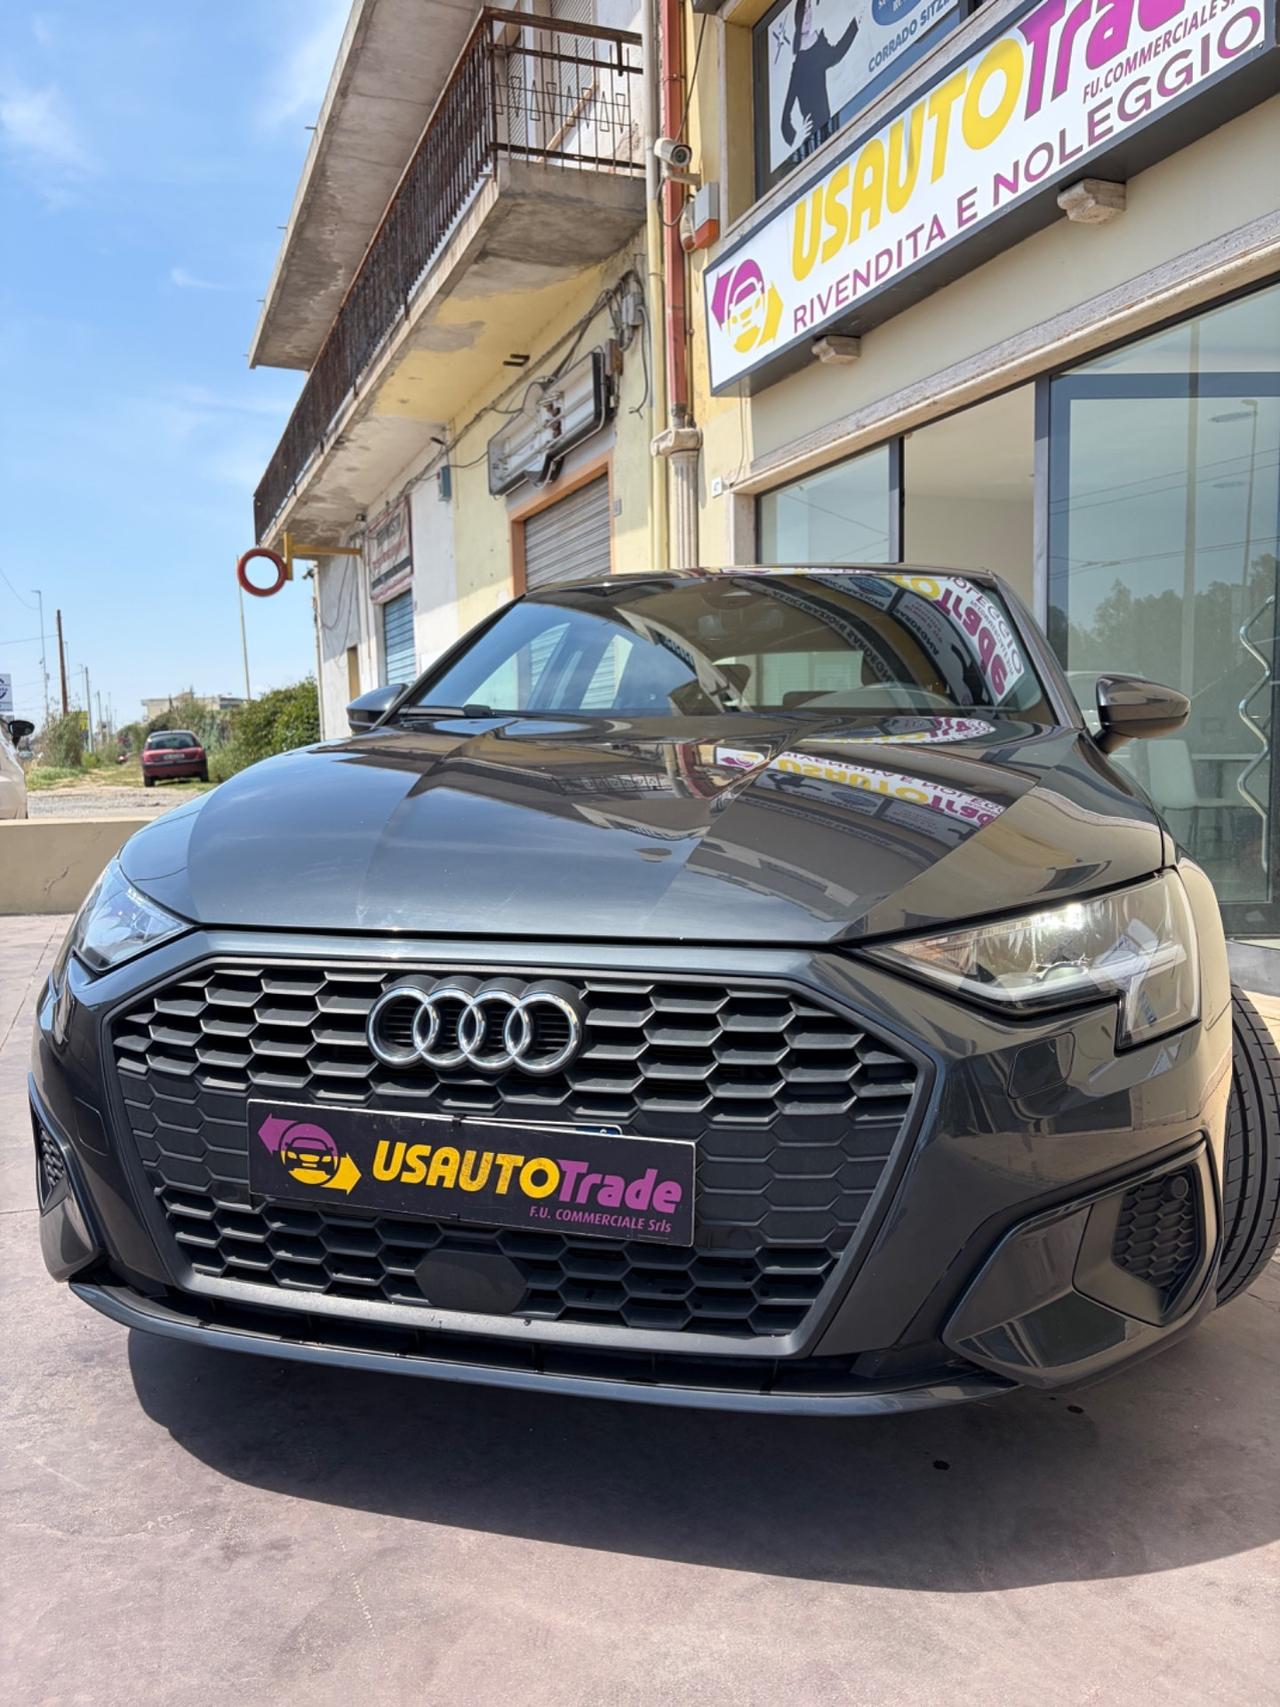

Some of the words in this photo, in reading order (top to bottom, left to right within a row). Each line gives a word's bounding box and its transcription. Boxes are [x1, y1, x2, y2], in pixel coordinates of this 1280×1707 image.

[868, 18, 918, 73] CORRADO
[793, 214, 947, 334] RIVENDITA
[956, 187, 978, 230] E
[992, 5, 1262, 207] NOLEGGIO
[529, 1205, 552, 1219] F.U.
[555, 1208, 646, 1230] COMMERCIALE
[647, 1218, 672, 1233] Srls
